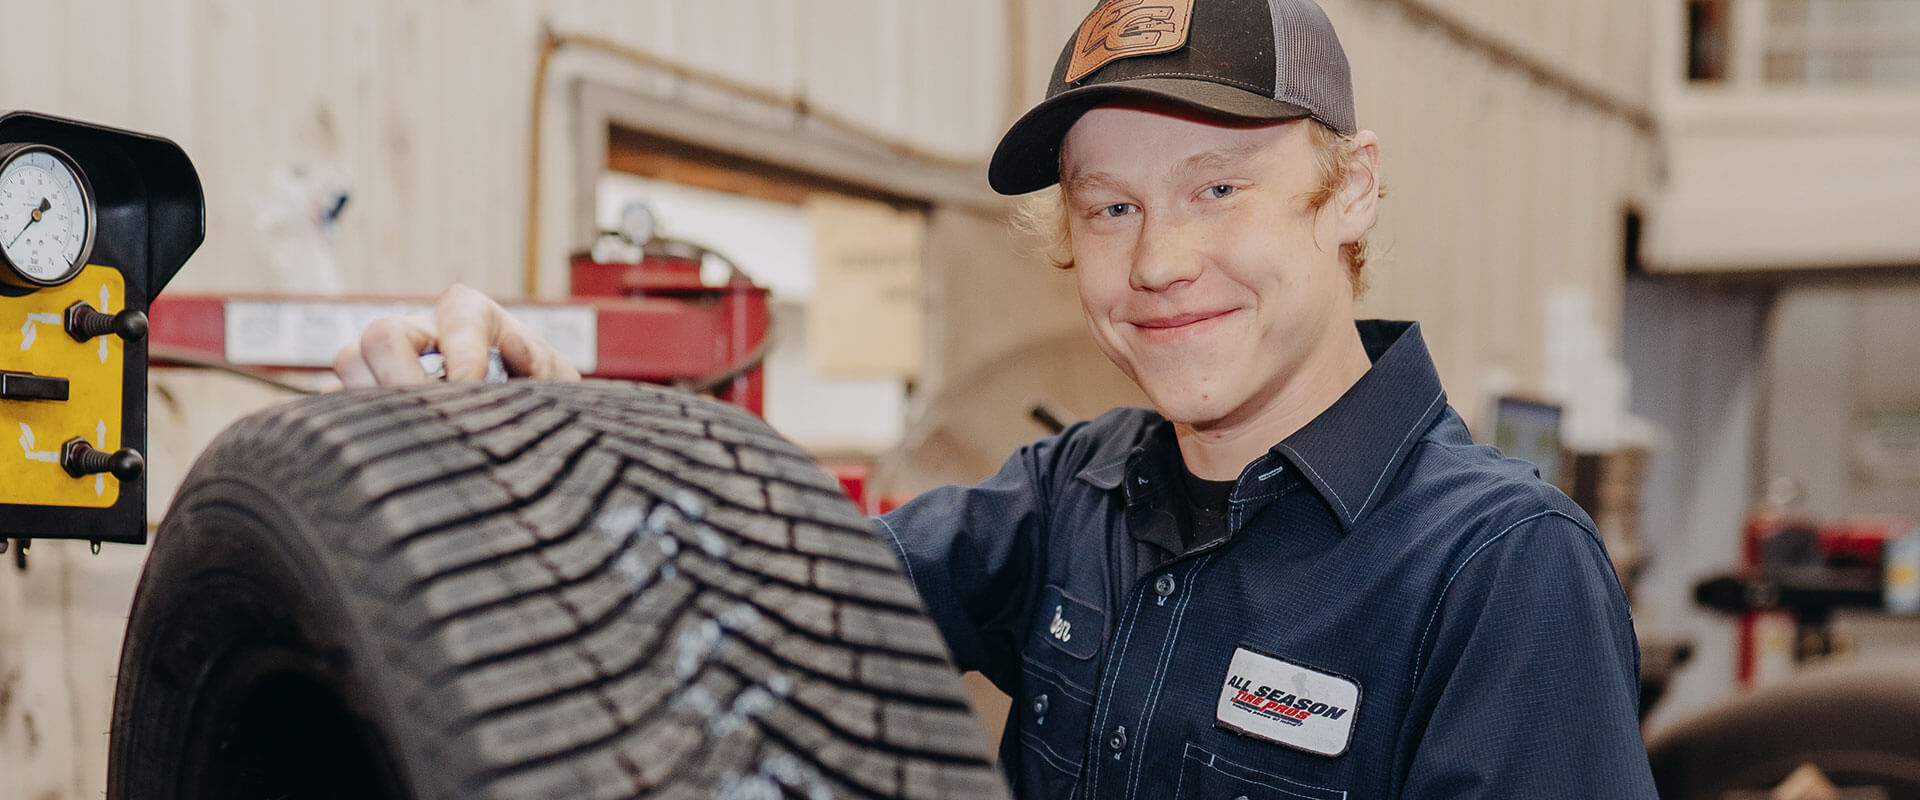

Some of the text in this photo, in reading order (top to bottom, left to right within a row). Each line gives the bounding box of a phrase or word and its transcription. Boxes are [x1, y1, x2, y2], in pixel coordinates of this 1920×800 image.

[1227, 675, 1251, 692] ALL
[1254, 685, 1348, 720] SEASON
[1232, 690, 1265, 705] TIRE
[1258, 700, 1312, 720] PROS
